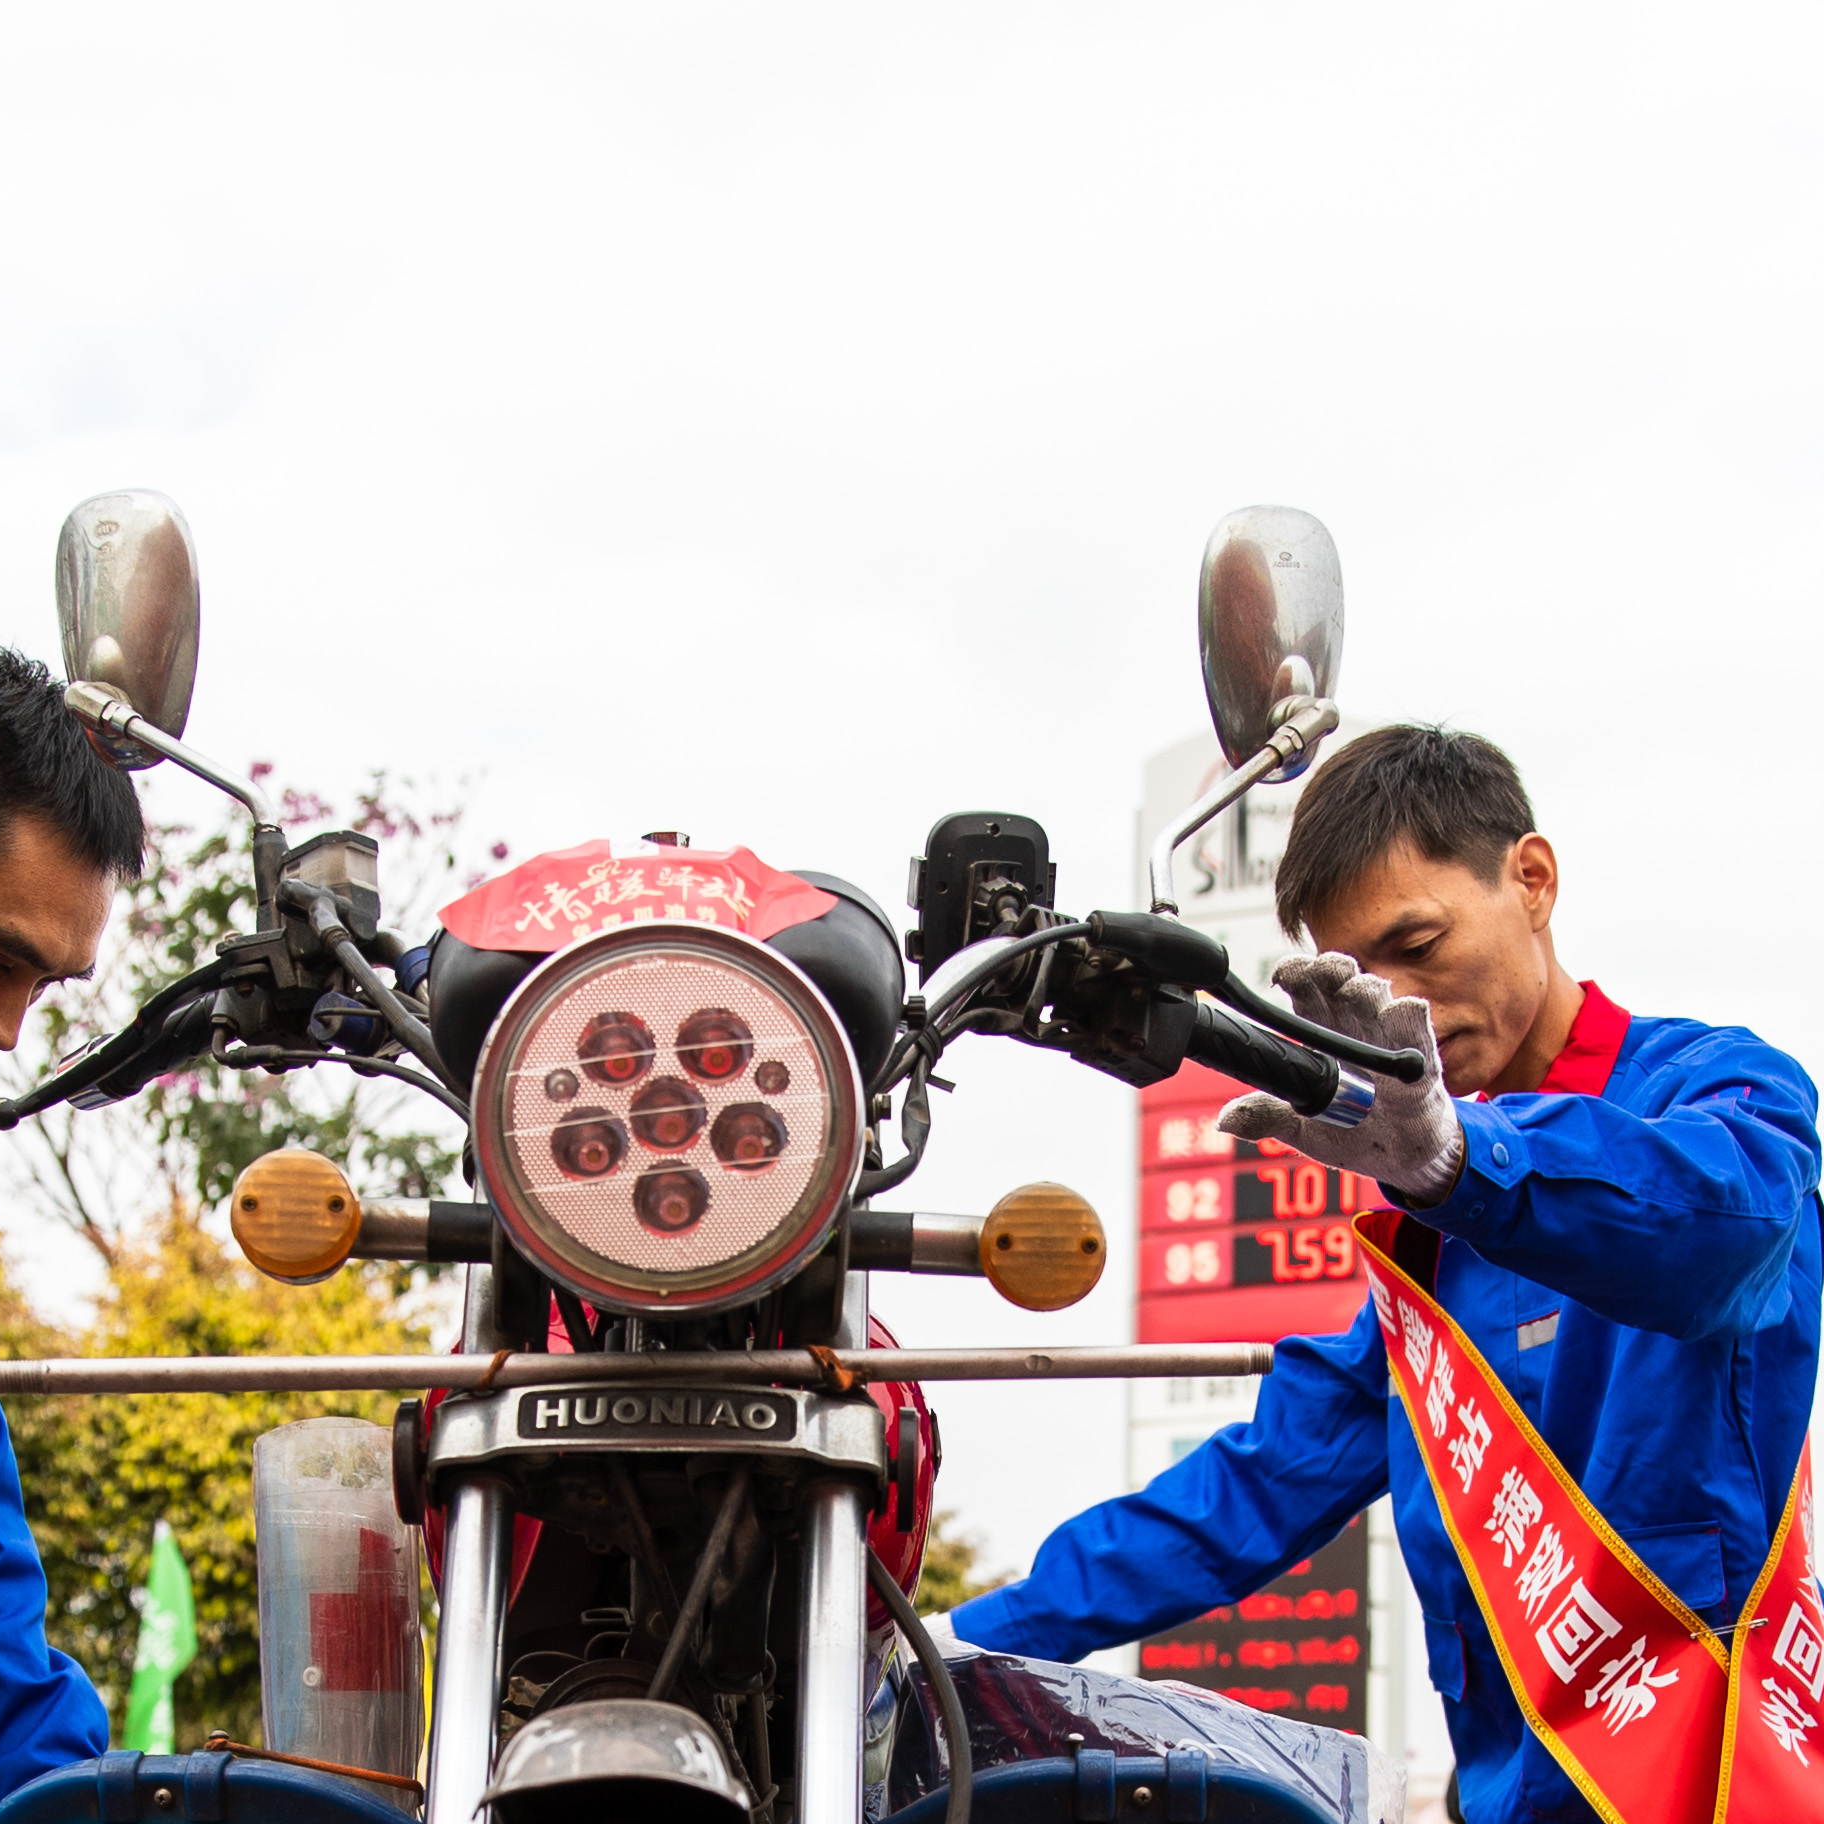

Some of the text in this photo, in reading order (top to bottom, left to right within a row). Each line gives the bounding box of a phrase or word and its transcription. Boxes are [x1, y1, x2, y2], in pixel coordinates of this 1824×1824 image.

[1167, 1178, 1220, 1222] 92
[1165, 1223, 1357, 1284] 95 7.59
[536, 1397, 777, 1430] HUONIAO
[1484, 1466, 1679, 1737] 满爱回家
